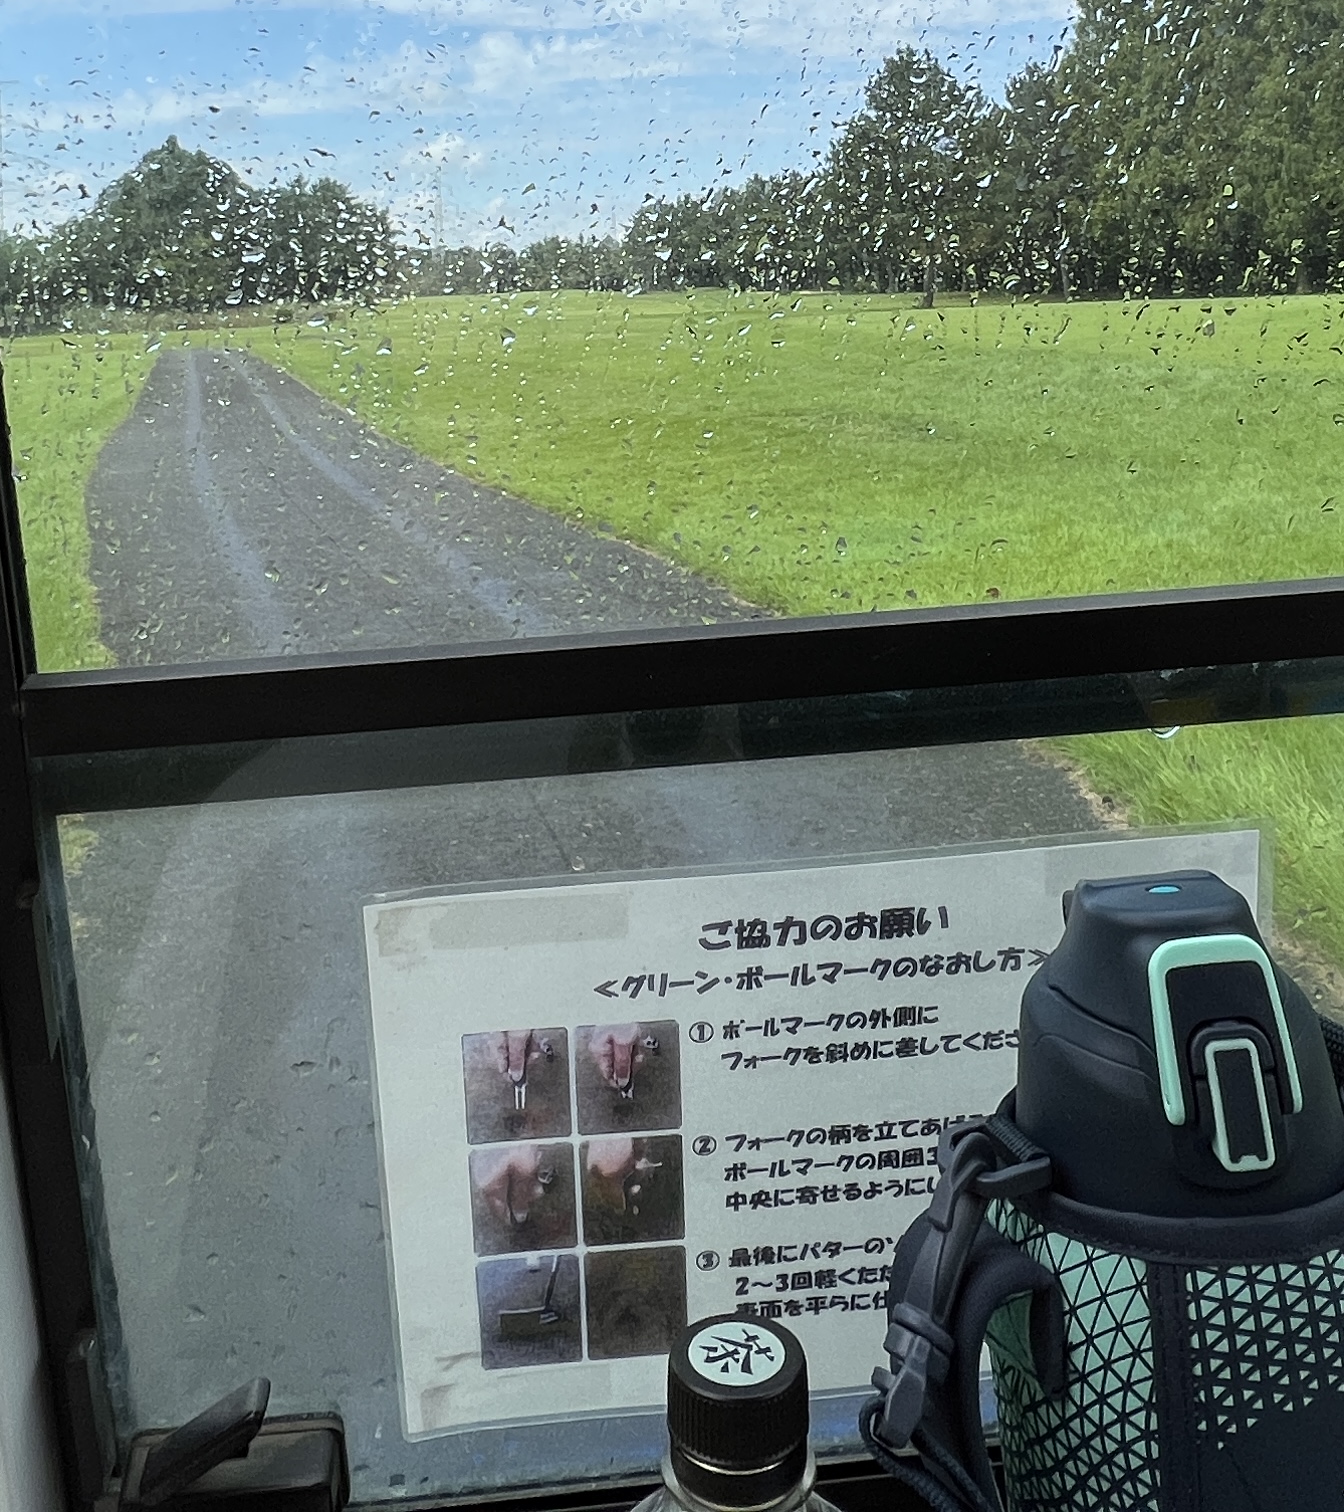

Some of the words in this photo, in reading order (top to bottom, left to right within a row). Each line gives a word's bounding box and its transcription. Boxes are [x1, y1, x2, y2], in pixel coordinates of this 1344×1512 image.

[697, 905, 950, 951] ご協力のお願い
[728, 1237, 893, 1268] 最後にパターの
[699, 1329, 775, 1375] 茶
